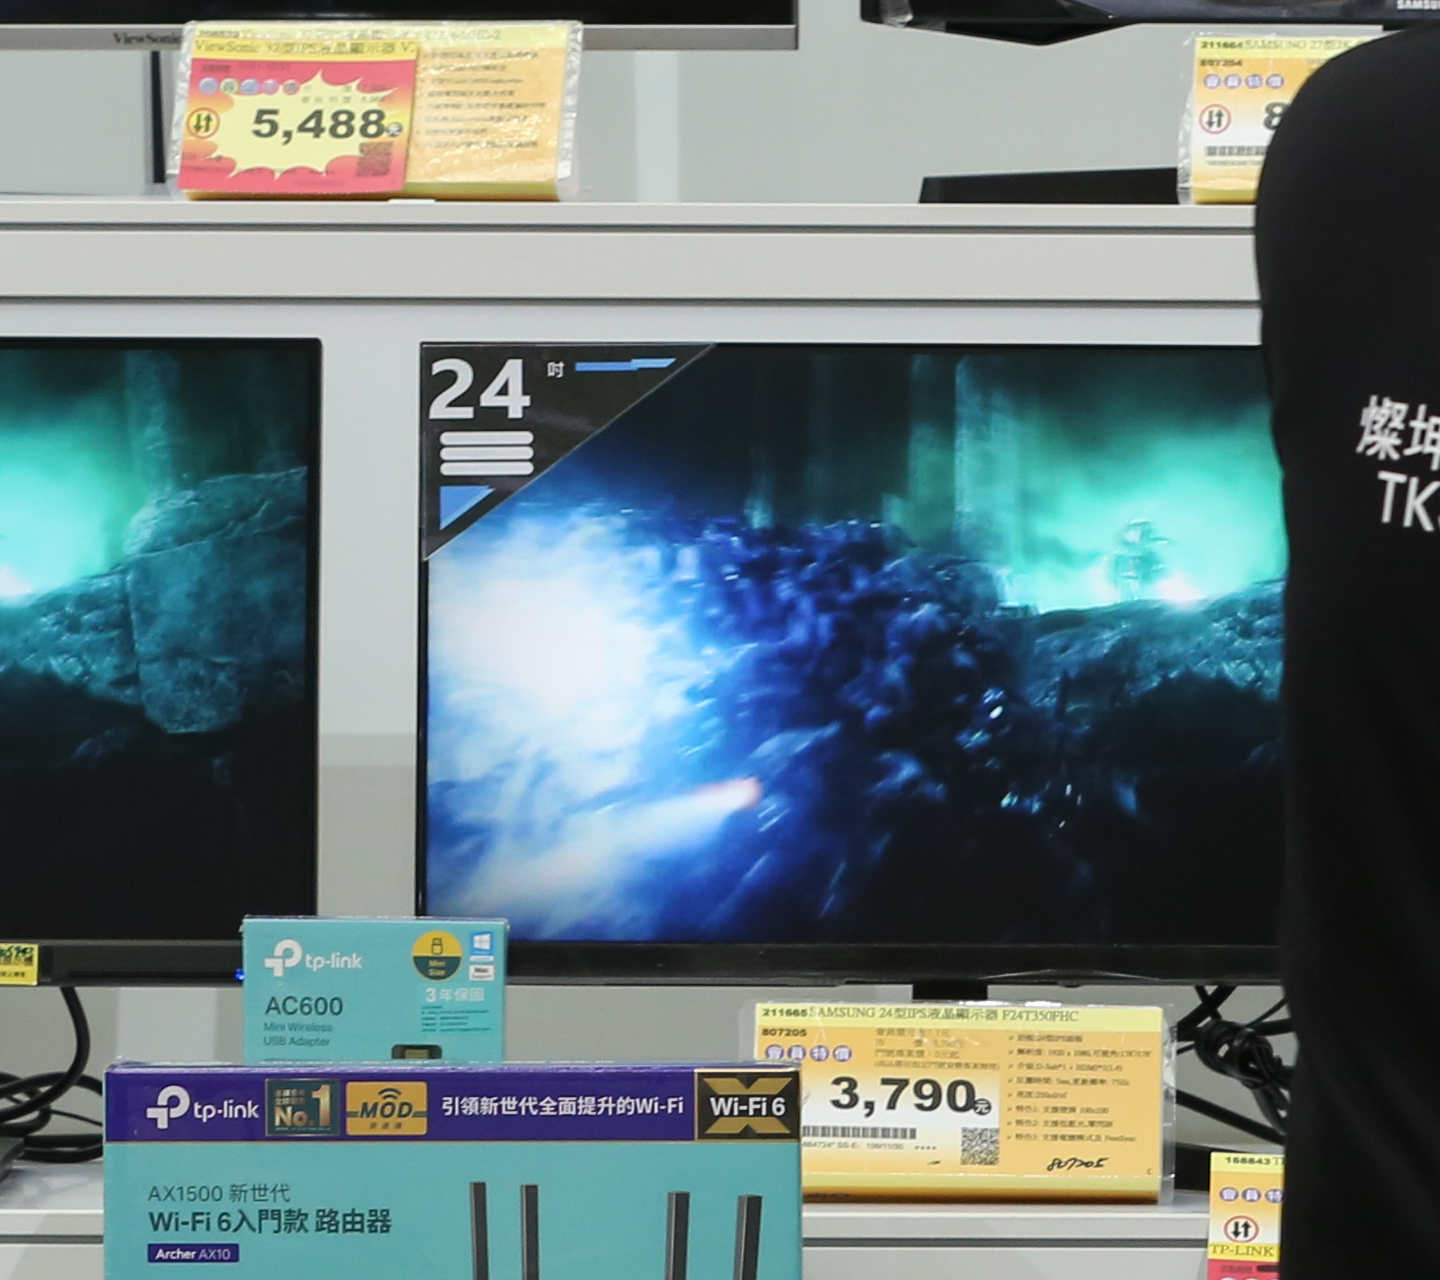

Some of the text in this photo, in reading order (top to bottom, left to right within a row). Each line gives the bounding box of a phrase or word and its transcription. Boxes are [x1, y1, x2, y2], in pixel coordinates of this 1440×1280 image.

[252, 108, 386, 146] 5,488
[428, 357, 532, 420] 24
[304, 951, 363, 973] tp-link
[264, 995, 344, 1016] AC600
[808, 1006, 876, 1019] SAMSUNG
[263, 1022, 333, 1033] Mini Wireless
[263, 1036, 331, 1048] USB Adapter
[441, 1095, 684, 1117] 引領新世代全面提升的Wi-Fi
[710, 1096, 786, 1117] Wi-Fi 6
[829, 1076, 992, 1119] 3,790 元
[192, 1098, 260, 1123] tp-link
[359, 1101, 414, 1119] MOD
[147, 1183, 292, 1203] AX1500 新世代
[148, 1207, 392, 1235] Wi-Fi 6入門款 路由器
[155, 1247, 231, 1261] Archer AX10
[1209, 1243, 1275, 1257] TP-LINK
